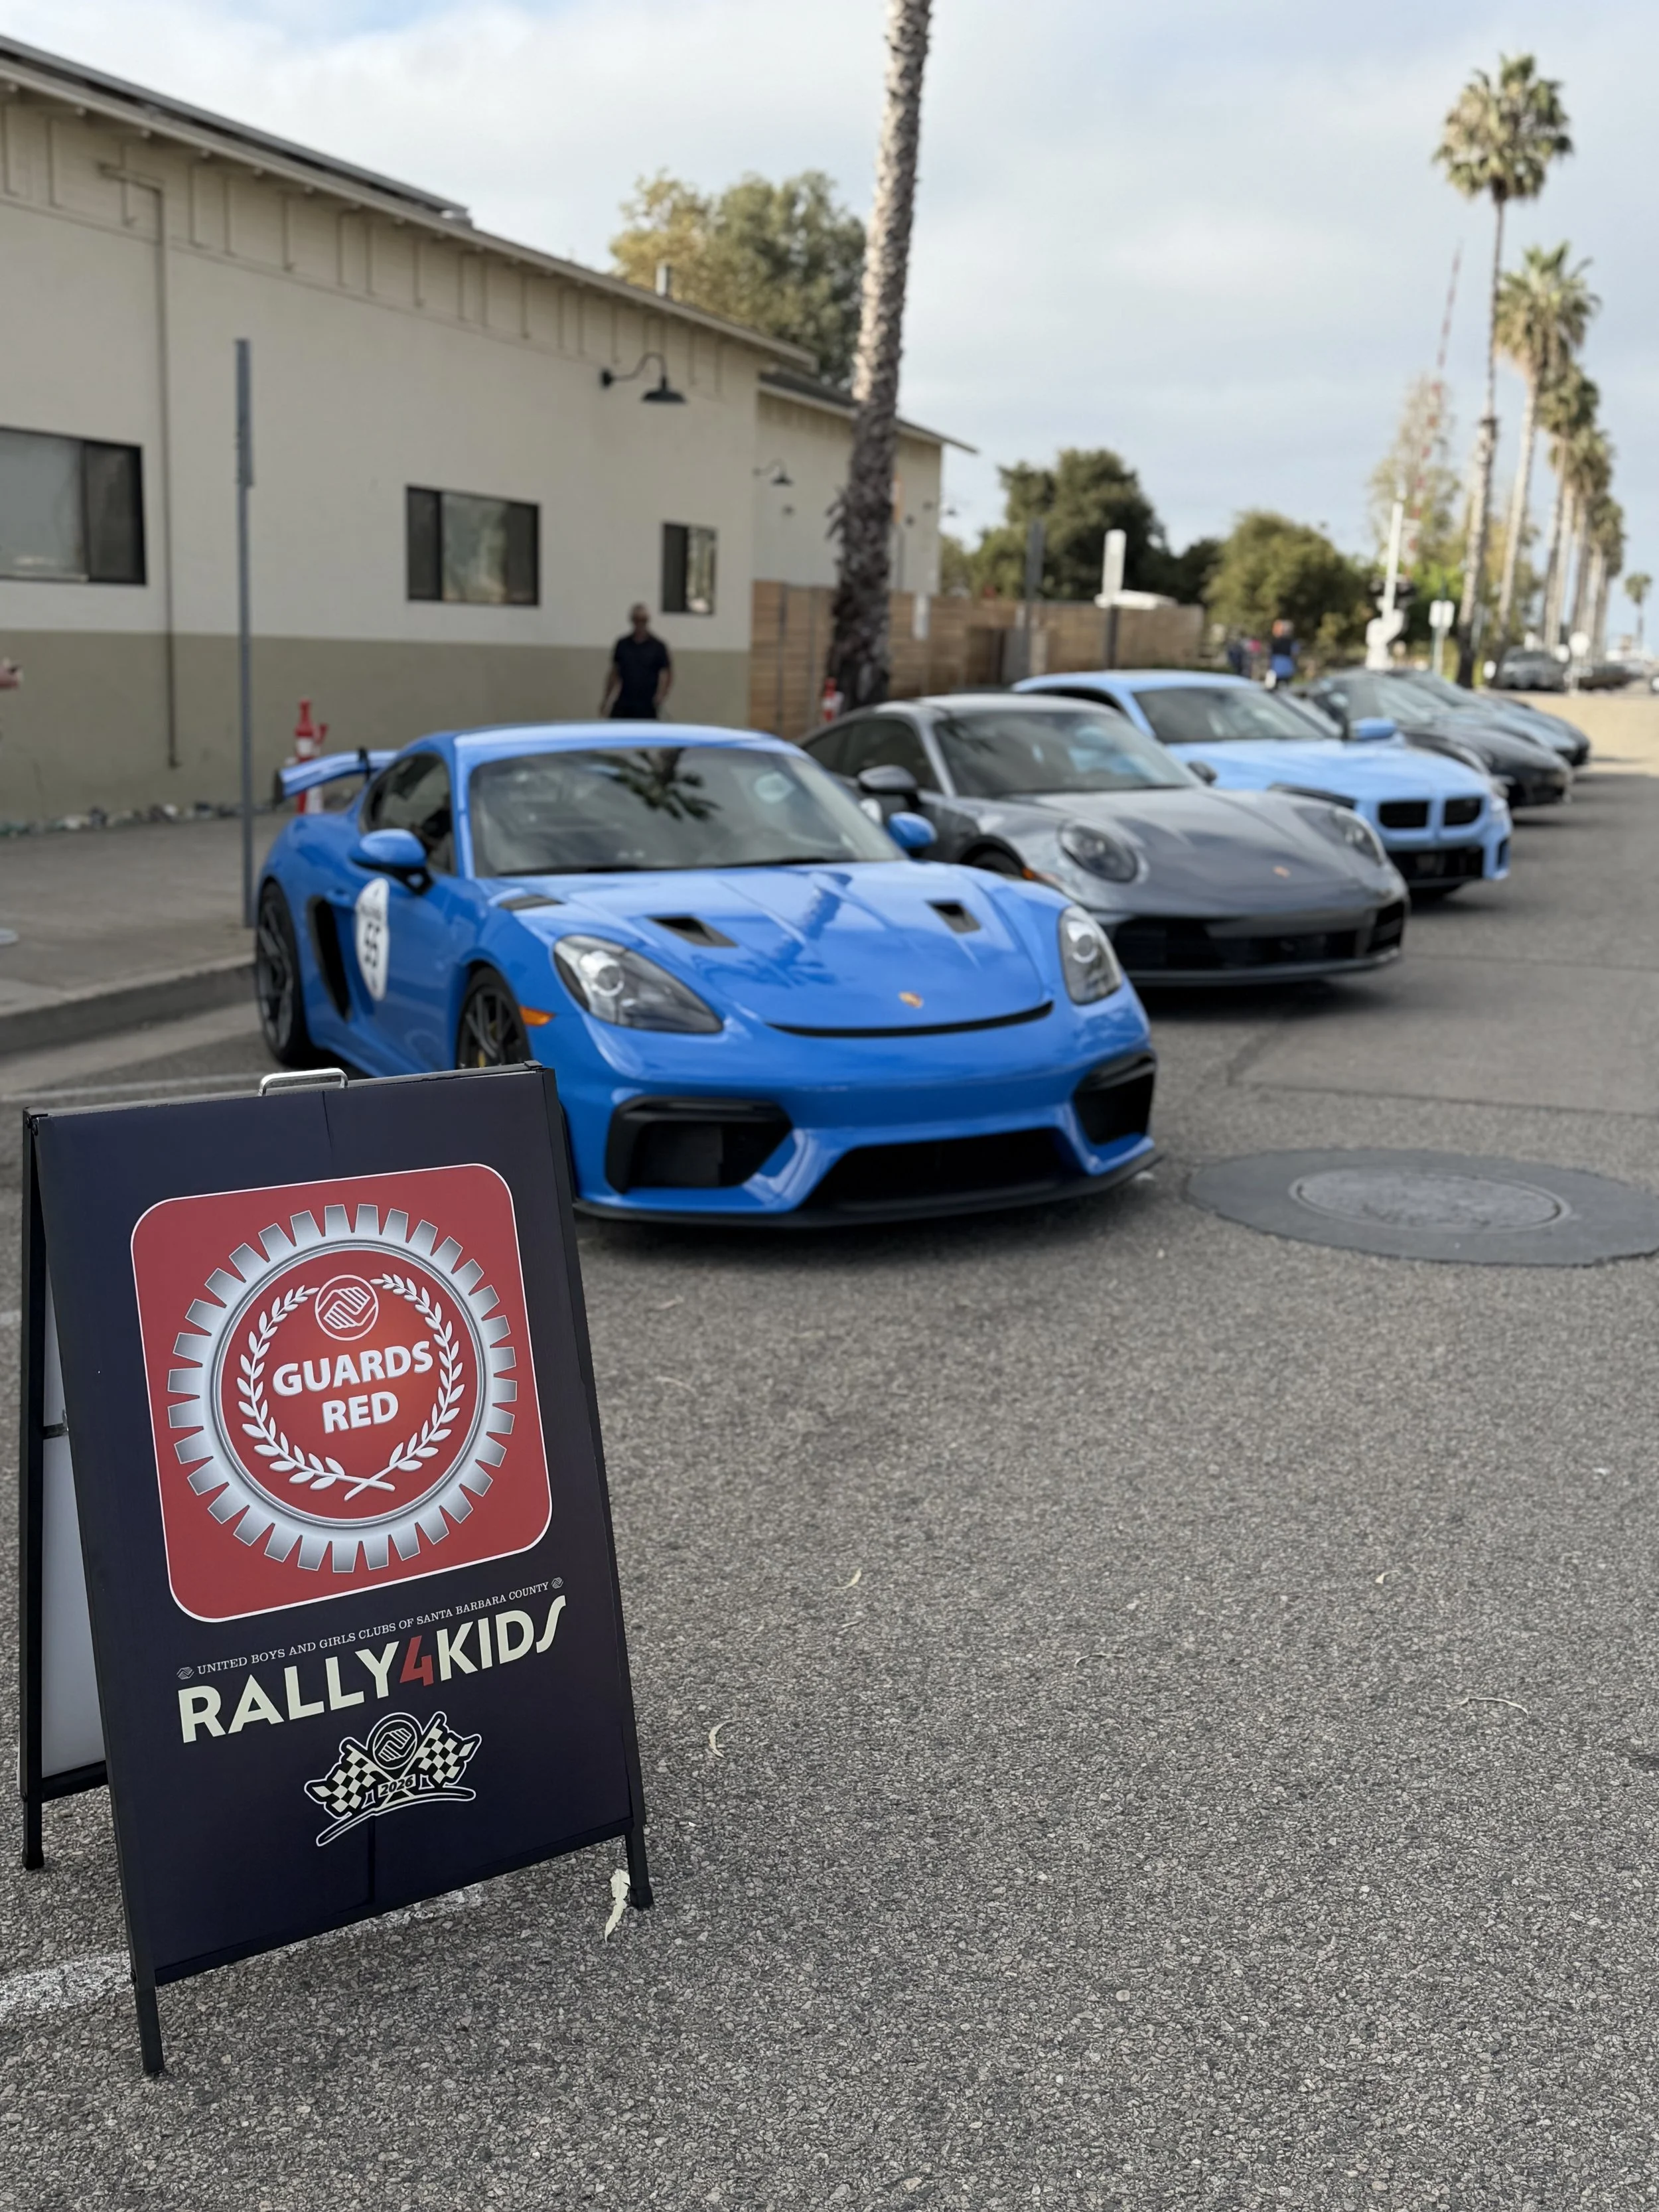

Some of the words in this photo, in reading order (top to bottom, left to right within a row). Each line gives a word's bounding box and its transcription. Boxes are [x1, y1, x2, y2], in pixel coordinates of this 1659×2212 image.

[273, 1341, 433, 1396] GUARDS
[322, 1391, 399, 1434] RED
[198, 1657, 248, 1674] UNITED
[251, 1649, 285, 1664] BOYS
[289, 1642, 316, 1656] AND
[319, 1633, 356, 1649] GIRLS
[358, 1623, 396, 1639] CLUBS
[399, 1618, 414, 1630] OF
[417, 1608, 453, 1625] SANTA
[456, 1594, 506, 1615] BARBARA
[509, 1582, 549, 1600] COUNTY
[178, 1595, 567, 1743] RALLY4KIDS
[380, 1775, 414, 1796] 2026
